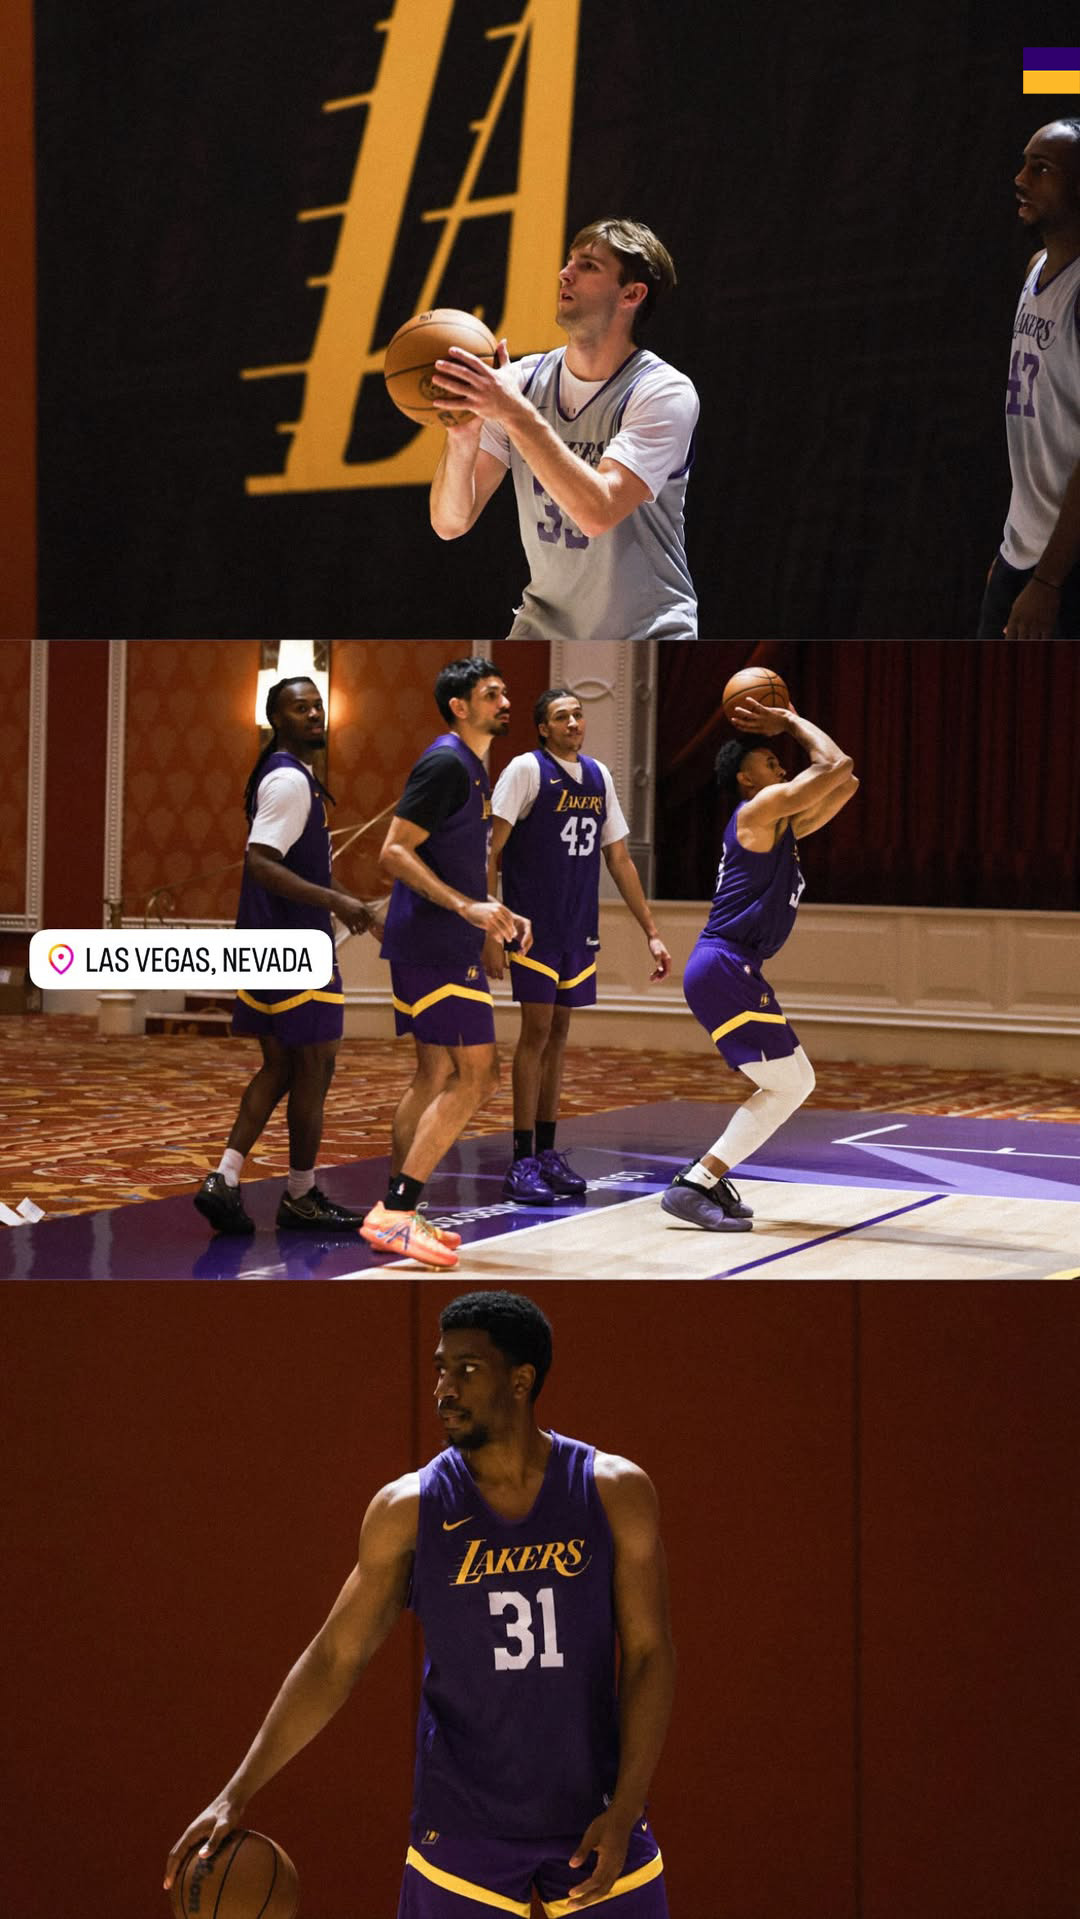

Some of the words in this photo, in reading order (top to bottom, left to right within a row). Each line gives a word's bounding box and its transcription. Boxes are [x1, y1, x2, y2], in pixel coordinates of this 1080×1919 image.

[553, 789, 604, 815] LAKERS
[560, 816, 598, 856] 43
[448, 1539, 592, 1586] LAKERS
[488, 1588, 564, 1671] 31
